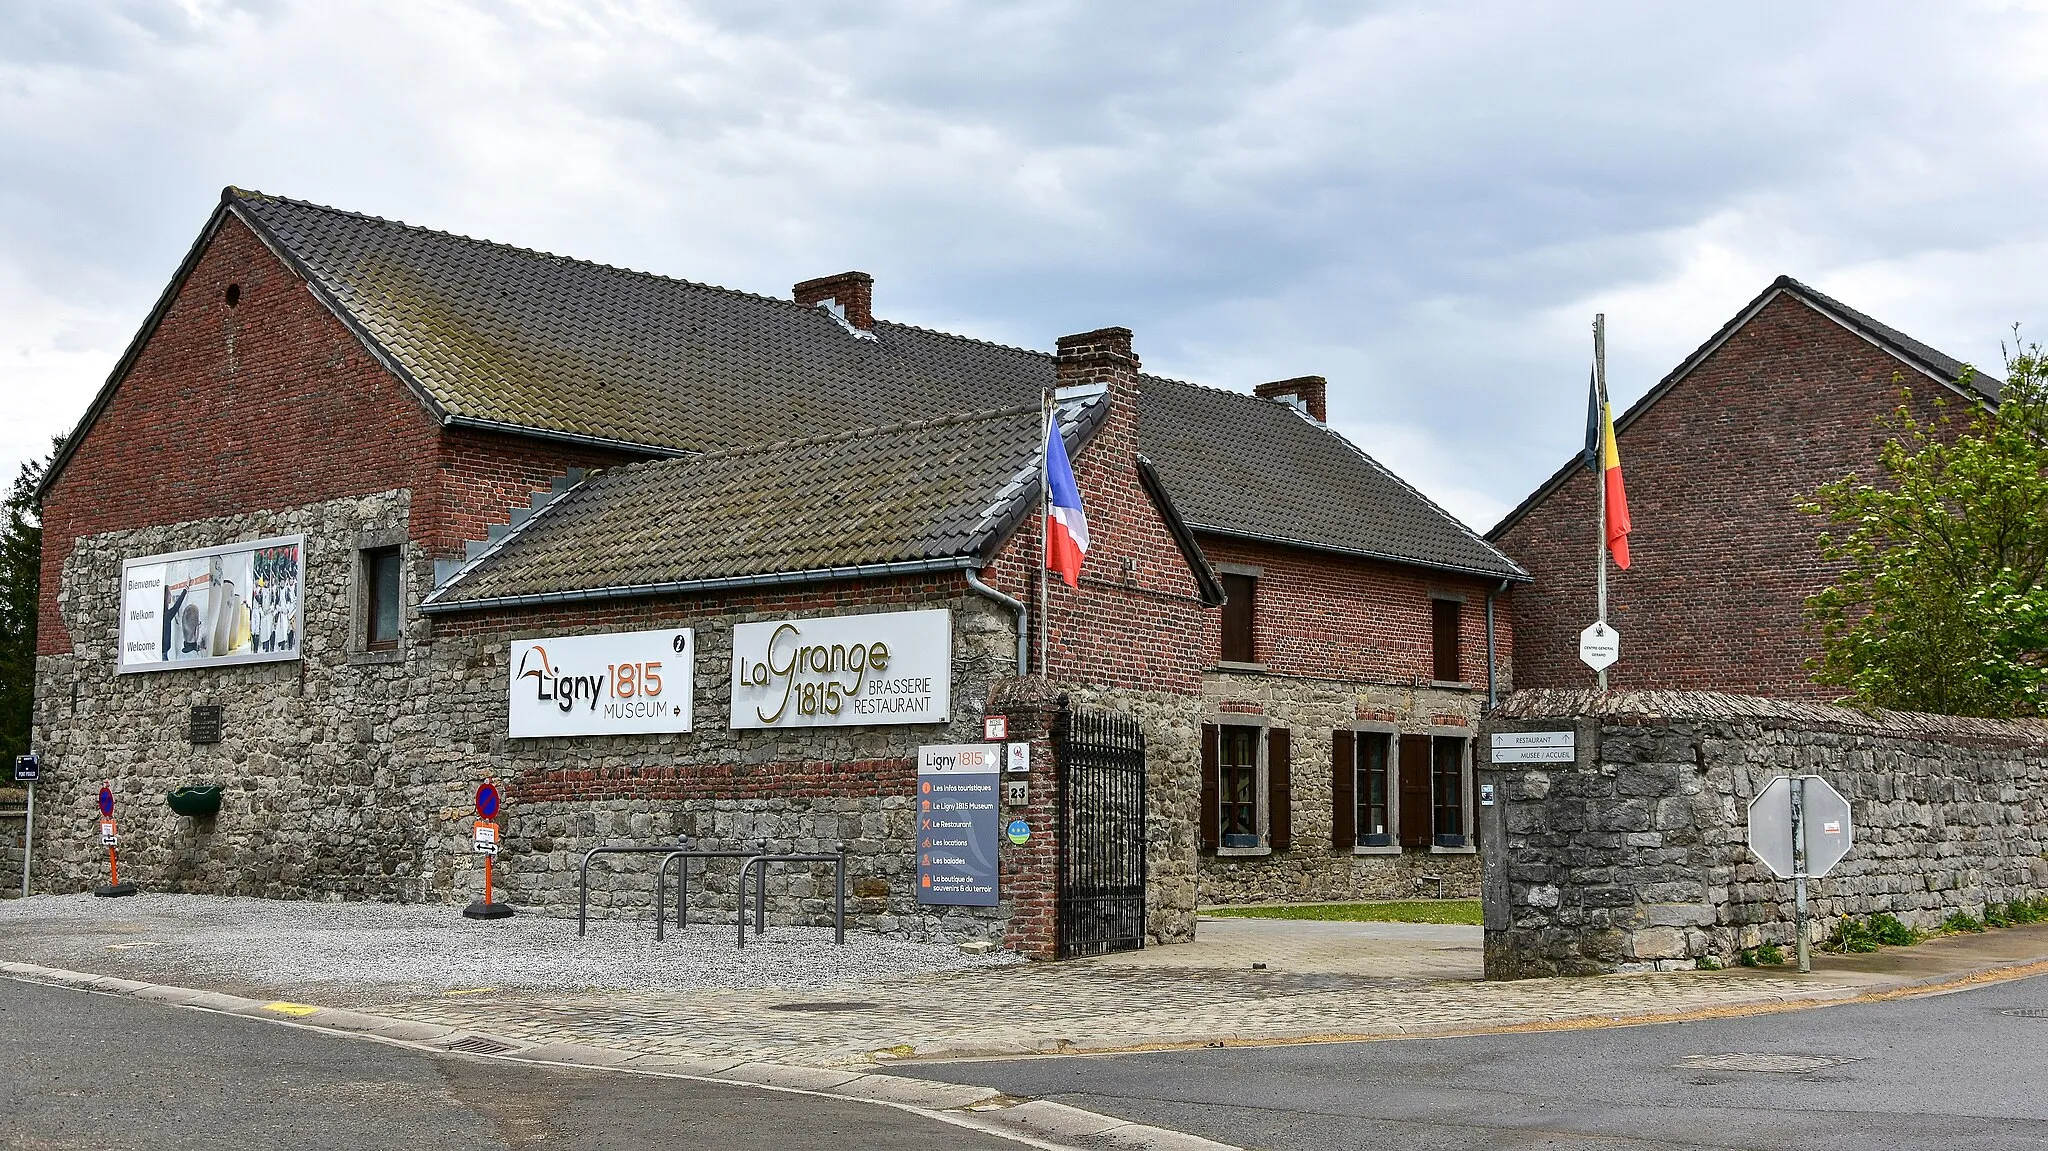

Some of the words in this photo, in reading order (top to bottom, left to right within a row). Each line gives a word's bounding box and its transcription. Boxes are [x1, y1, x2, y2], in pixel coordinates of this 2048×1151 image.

[128, 579, 160, 590] Bienvenue
[130, 610, 154, 620] Welkom
[127, 642, 156, 652] Welcome
[538, 665, 604, 712] Ligny
[608, 661, 663, 698] 1815
[869, 677, 932, 696] BRASSERIE
[794, 681, 841, 715] 1815
[854, 696, 932, 715] RESTAURANT
[926, 752, 956, 770] Ligny
[958, 752, 983, 766] 1815
[958, 784, 992, 792] touristiques
[1010, 788, 1026, 798] 23
[941, 803, 956, 812] Ligny
[941, 875, 965, 884] boutique
